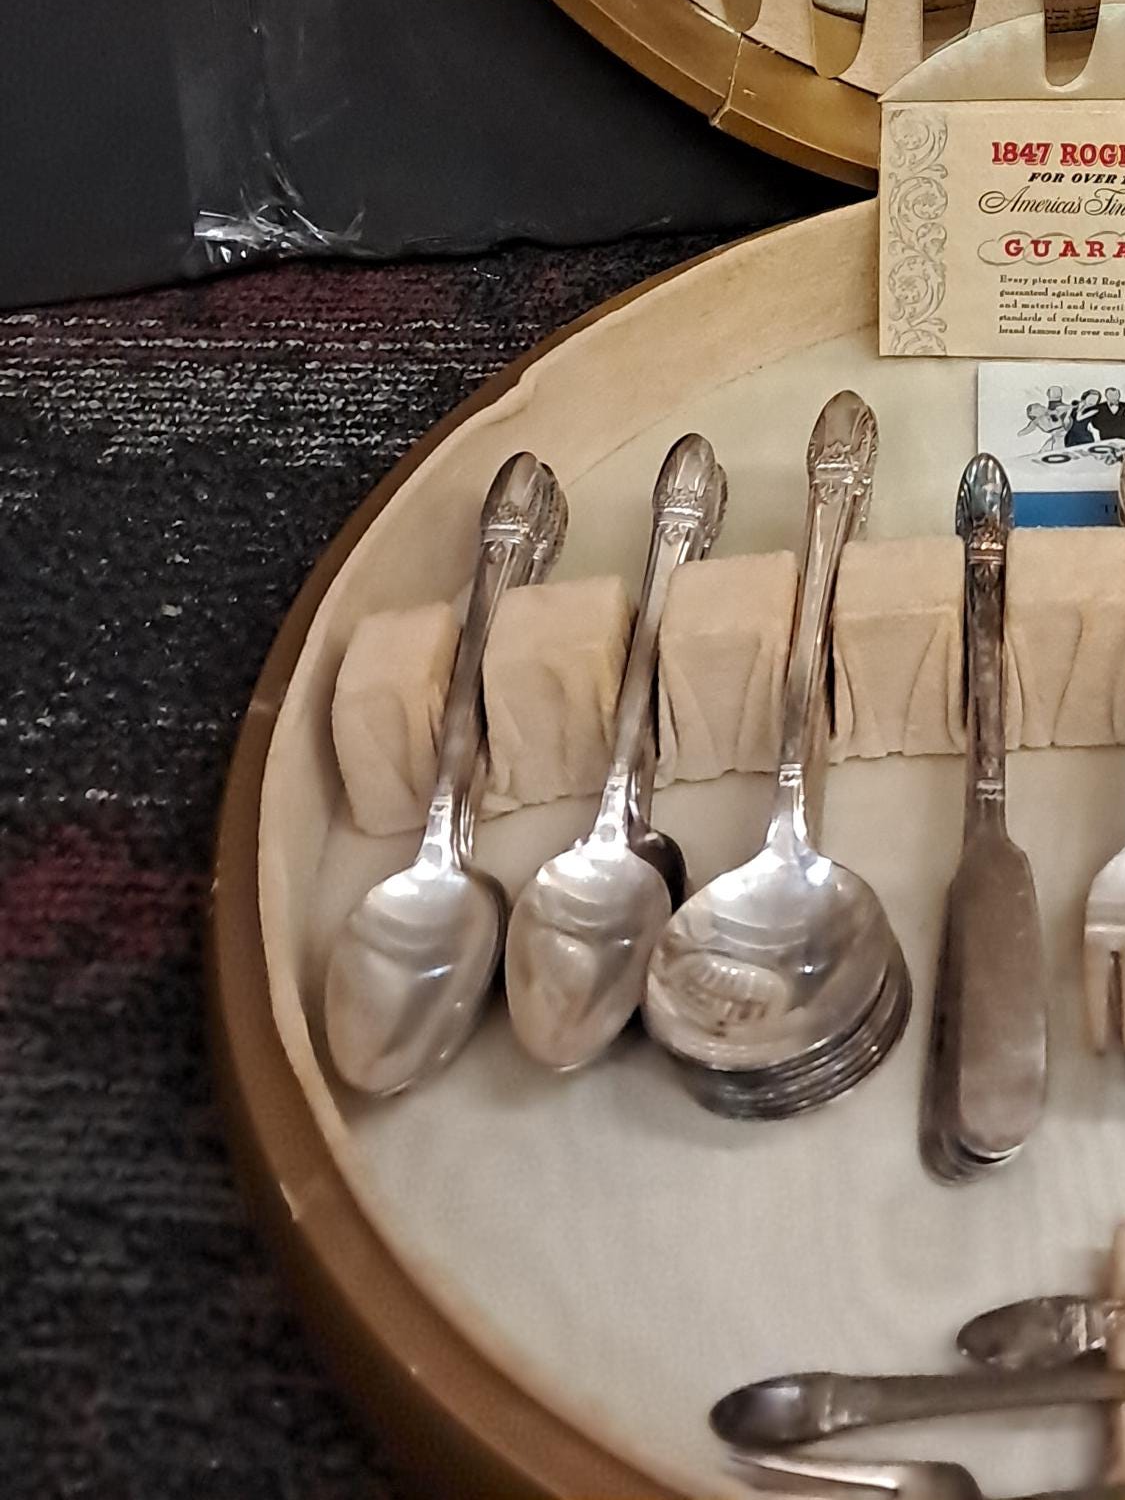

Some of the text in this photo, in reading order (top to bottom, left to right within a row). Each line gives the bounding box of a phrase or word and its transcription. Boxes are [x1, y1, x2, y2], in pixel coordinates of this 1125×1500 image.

[991, 142, 1052, 166] 1847
[1028, 172, 1064, 183] FOR
[1071, 173, 1117, 184] OVER
[979, 186, 1082, 214] America's
[1000, 274, 1028, 285] Every
[1032, 277, 1057, 286] piece
[1060, 275, 1071, 284] of
[1073, 276, 1097, 285] 1847
[1000, 287, 1048, 297] guaranteed
[1052, 290, 1083, 298] against
[1086, 290, 1121, 299] original
[999, 300, 1017, 308] and
[1021, 300, 1063, 309] material
[1067, 300, 1085, 309] and
[999, 312, 1042, 321] standards
[1047, 313, 1056, 321] of
[1062, 314, 1125, 325] craftsmanship
[999, 325, 1025, 334] brand
[1029, 325, 1060, 335] famous
[1064, 326, 1077, 335] for
